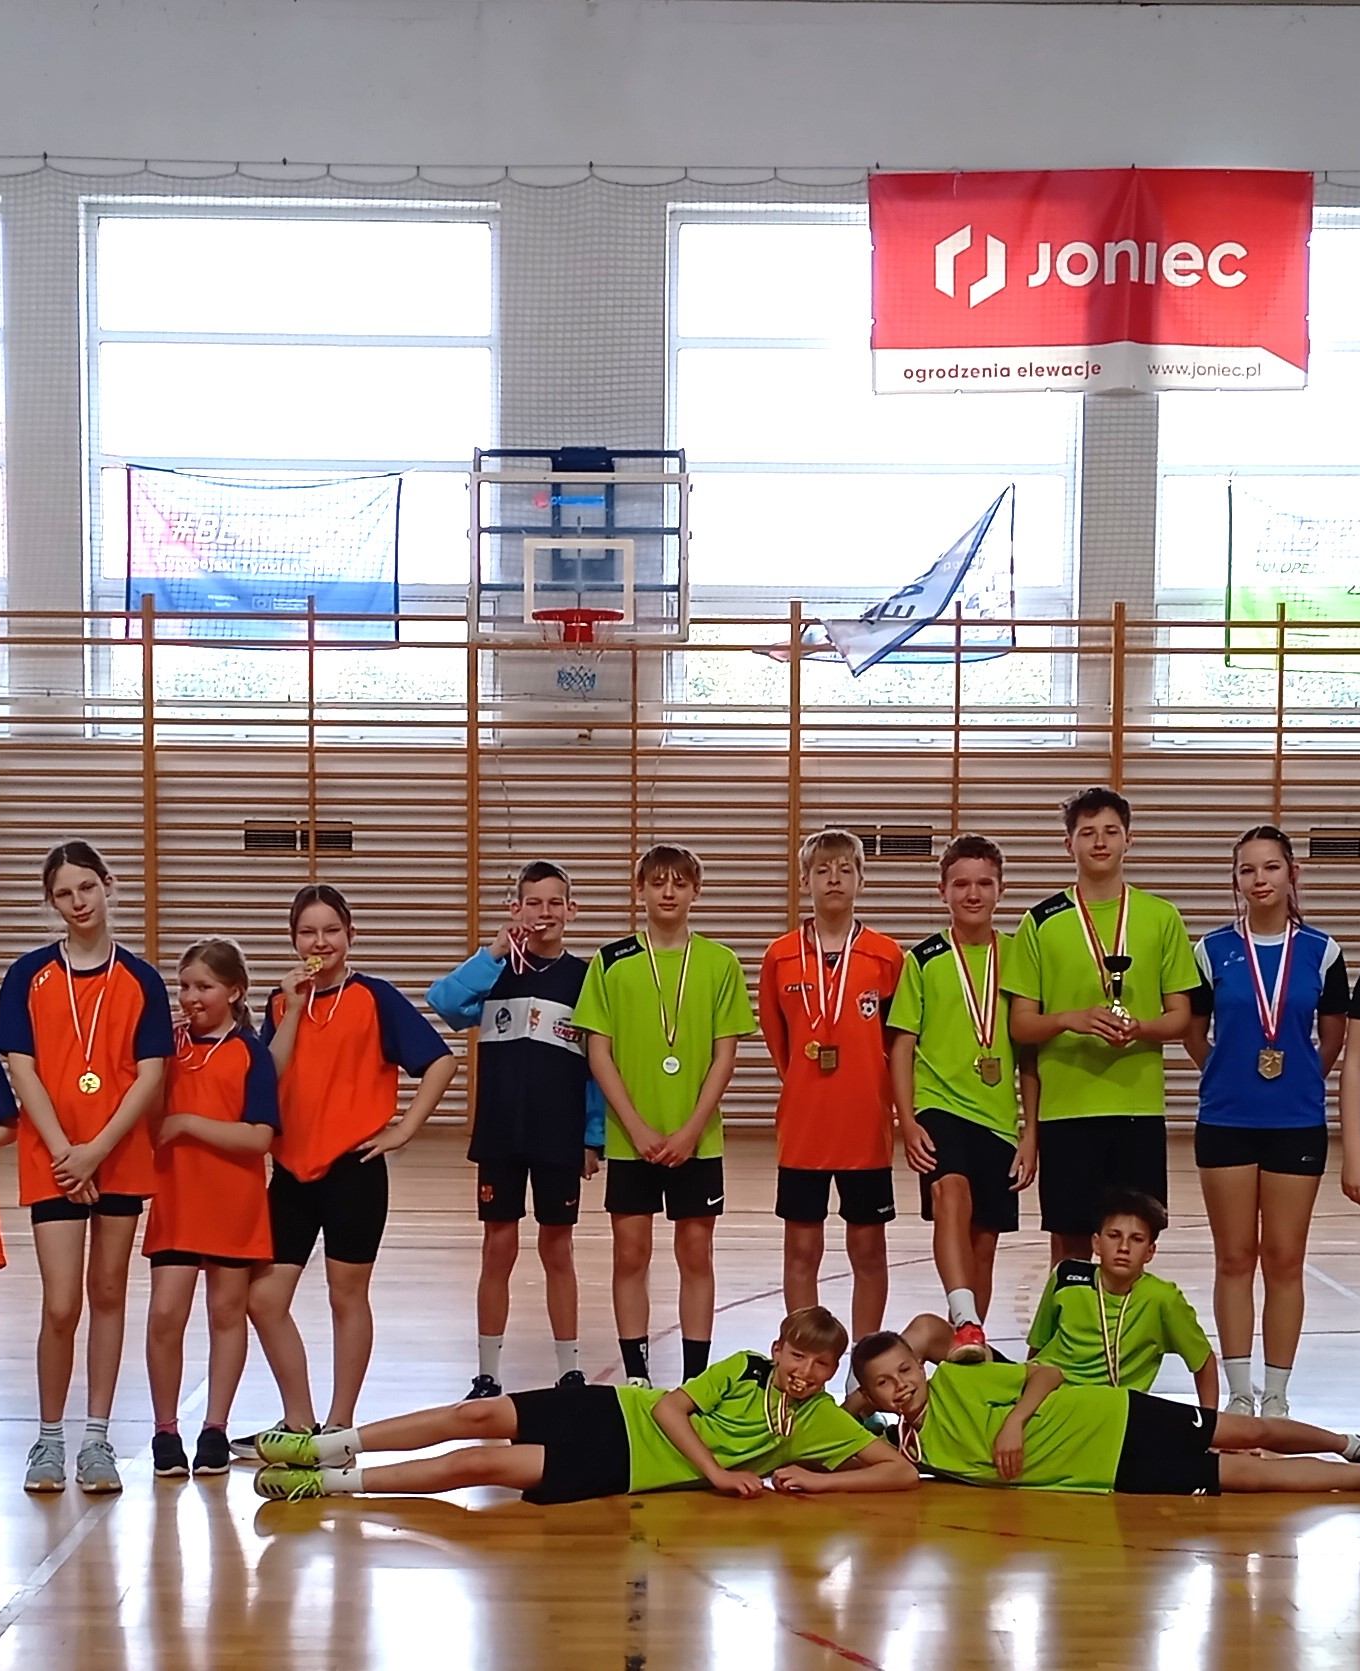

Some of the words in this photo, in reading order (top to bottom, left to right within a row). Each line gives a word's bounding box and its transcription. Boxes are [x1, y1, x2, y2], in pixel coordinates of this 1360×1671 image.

[903, 364, 1010, 382] ogrodzenia
[1017, 361, 1101, 380] elewacje
[1147, 362, 1261, 381] www.joniec.pl
